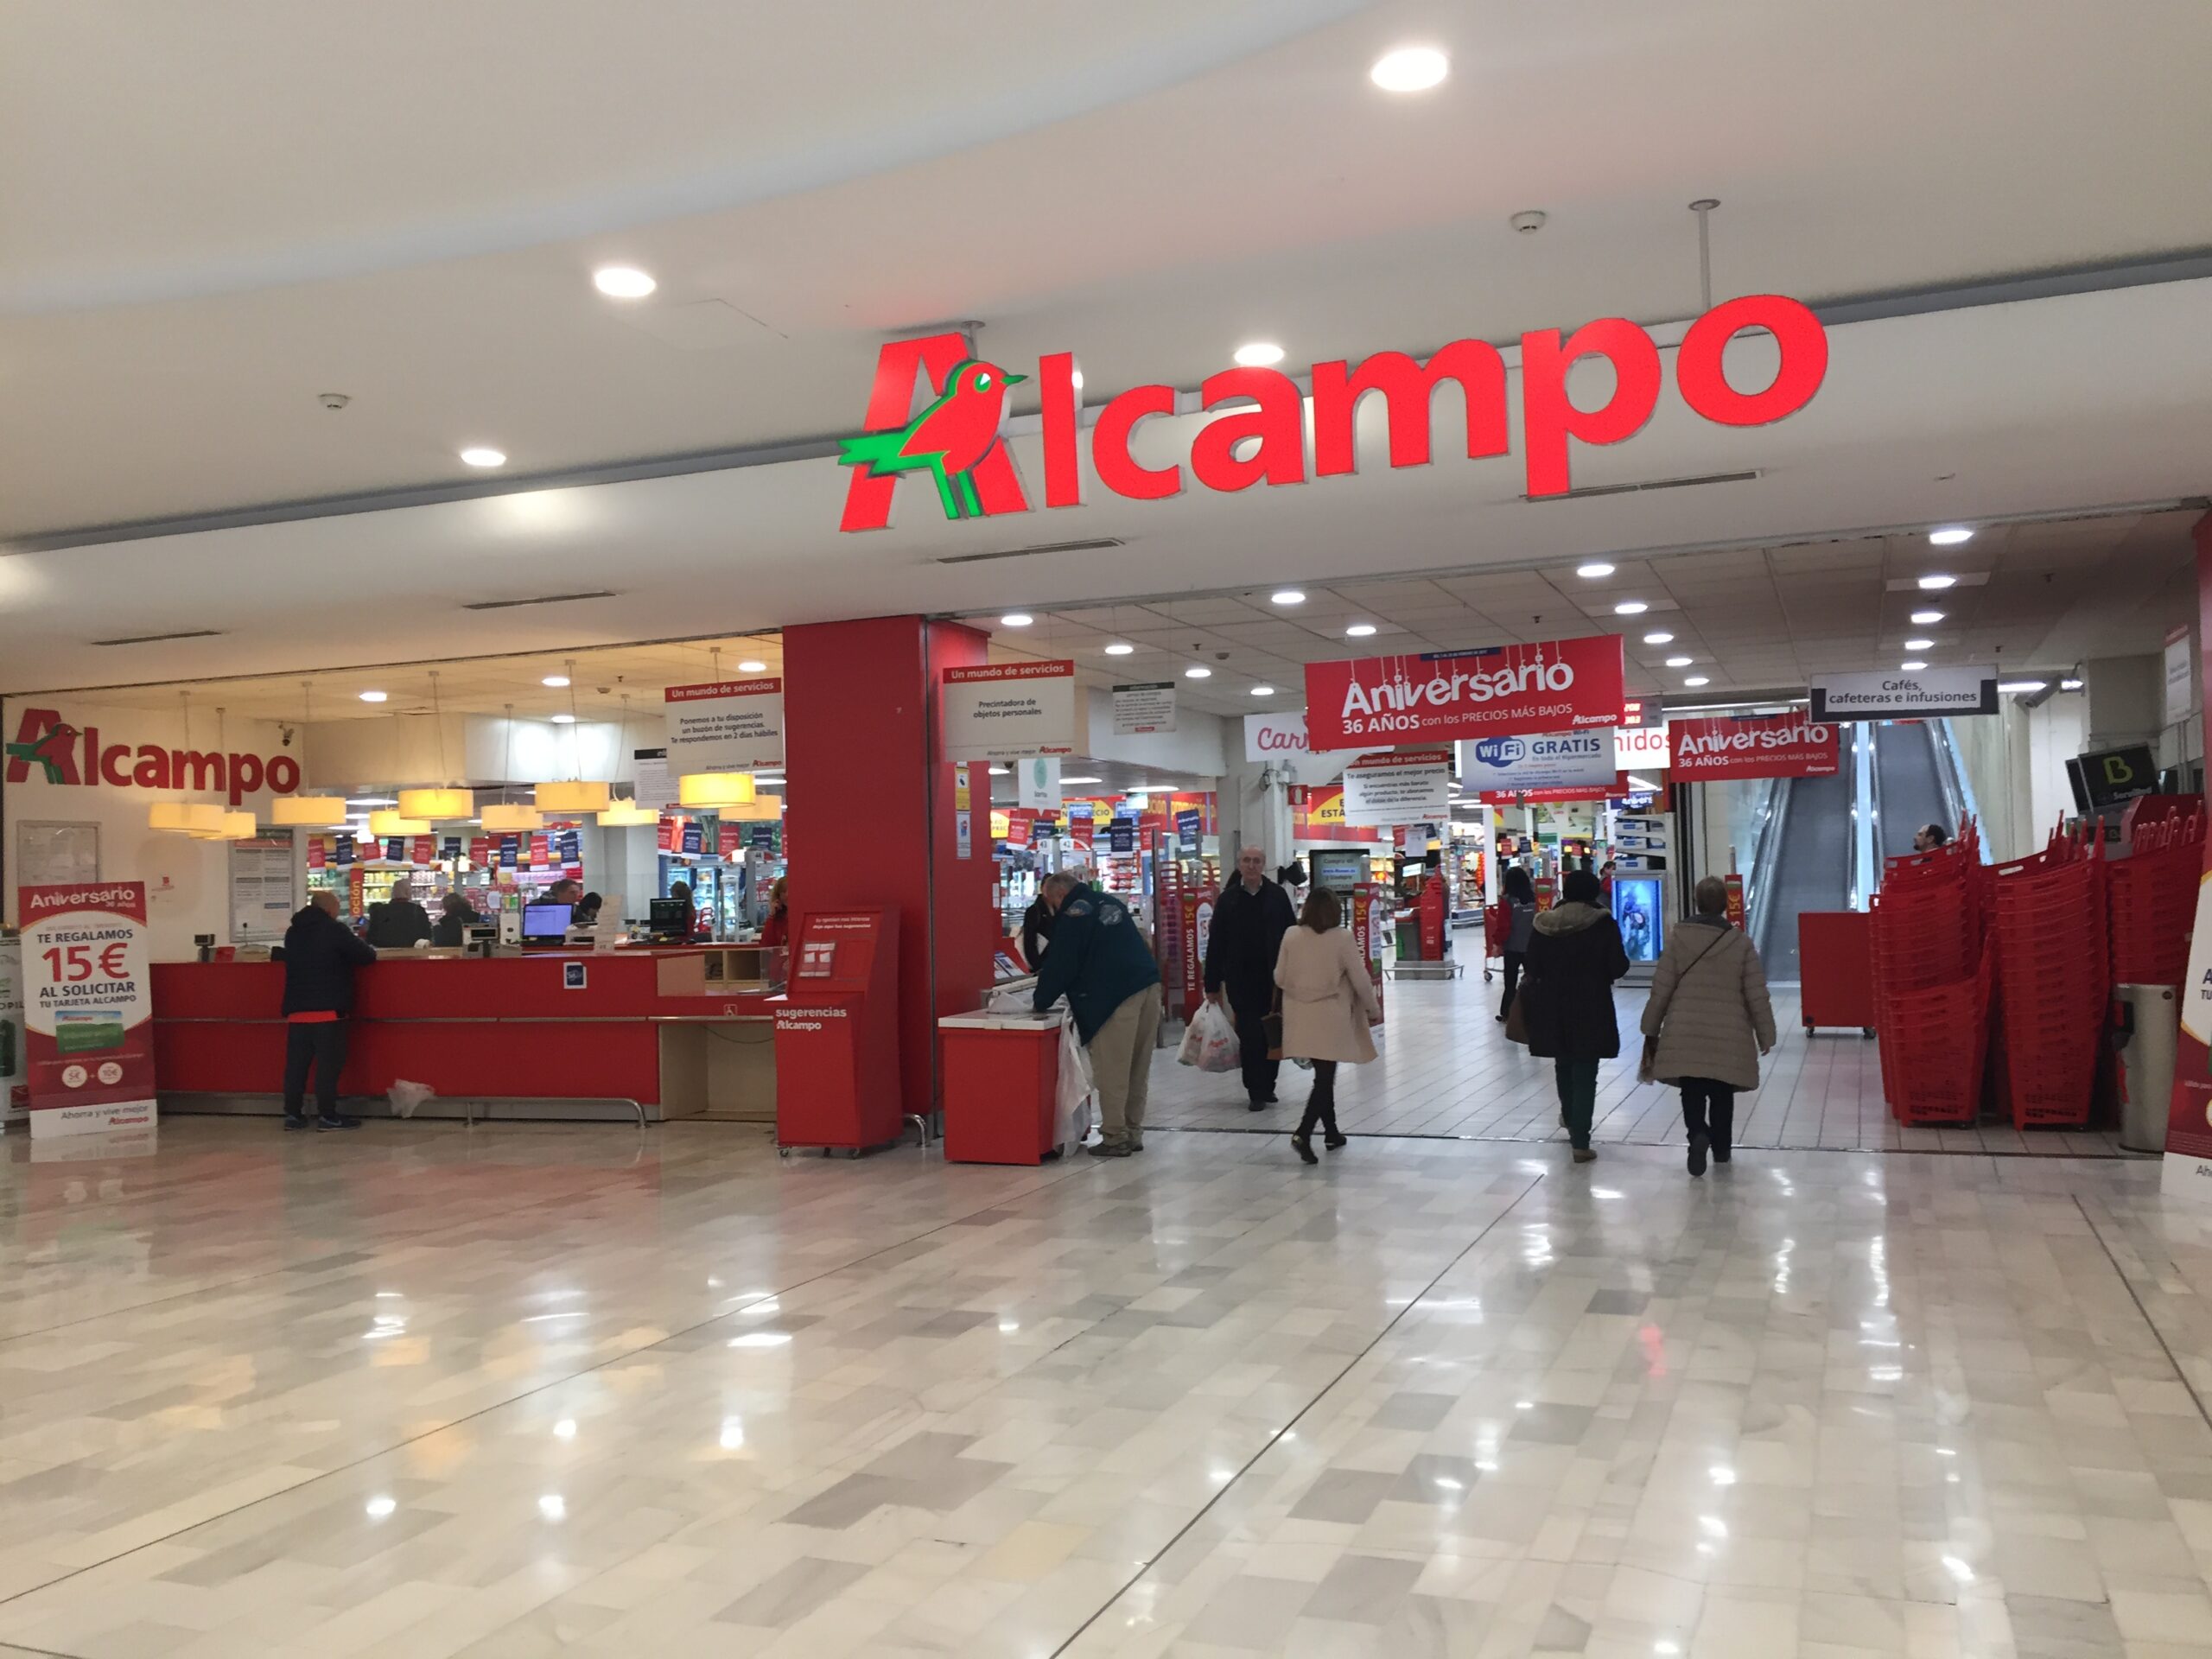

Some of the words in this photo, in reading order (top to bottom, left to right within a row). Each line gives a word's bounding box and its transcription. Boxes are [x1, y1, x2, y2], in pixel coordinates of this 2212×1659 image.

[839, 295, 1828, 532] Alcampo
[951, 670, 965, 679] Un
[967, 667, 1002, 678] mundo
[1004, 665, 1018, 676] de
[1020, 663, 1065, 675] servicios
[671, 690, 684, 698] Un
[686, 687, 718, 696] mundo
[720, 684, 732, 694] de
[734, 682, 774, 692] servicios
[1342, 657, 1573, 717] Aniversario
[1882, 679, 1923, 692] Cafés,
[978, 699, 1025, 709] Precintadora
[1829, 692, 1891, 704] cafeteras
[1894, 694, 1904, 703] e
[1906, 691, 1978, 703] infusiones
[726, 712, 764, 722] disposición
[973, 709, 1001, 720] objetos
[1001, 708, 1042, 718] personales
[1342, 719, 1363, 734] 36
[1367, 714, 1421, 733] AÑOS
[1421, 716, 1442, 726] con
[1444, 714, 1460, 724] los
[1462, 709, 1510, 722] PRECIOS
[1511, 705, 1536, 719] MÁS
[1538, 702, 1573, 716] BAJOS
[1571, 713, 1618, 725] Alcampo
[679, 734, 723, 745] respondemos
[1257, 727, 1307, 750] Car
[1678, 722, 1828, 757] Aniversario
[1039, 746, 1072, 755] Alcampo
[1532, 738, 1601, 755] GRATIS
[6, 709, 301, 806] Alcampo
[1404, 753, 1442, 762] servicios
[1678, 758, 1693, 768] 36
[1694, 754, 1729, 767] AÑOS
[1756, 753, 1787, 763] PRECIOS
[1356, 771, 1395, 780] aseguramos
[1404, 768, 1423, 777] mejor
[1424, 767, 1446, 776] precio
[2102, 756, 2133, 785] B
[1496, 790, 1508, 798] 36
[30, 886, 136, 909] Aniversario
[37, 933, 52, 944] TE
[55, 929, 134, 943] REGALAMOS
[1186, 928, 1195, 980] REGALAMOS
[40, 987, 58, 998] AL
[62, 982, 136, 996] SOLICITAR
[54, 998, 91, 1007] TARJETA
[92, 995, 137, 1006] ALCAMPO
[775, 1007, 848, 1020] sugerencias
[777, 1020, 823, 1032] Alcampo
[103, 1107, 120, 1116] vive
[122, 1104, 149, 1116] mejor
[108, 1116, 149, 1126] Alcampo
